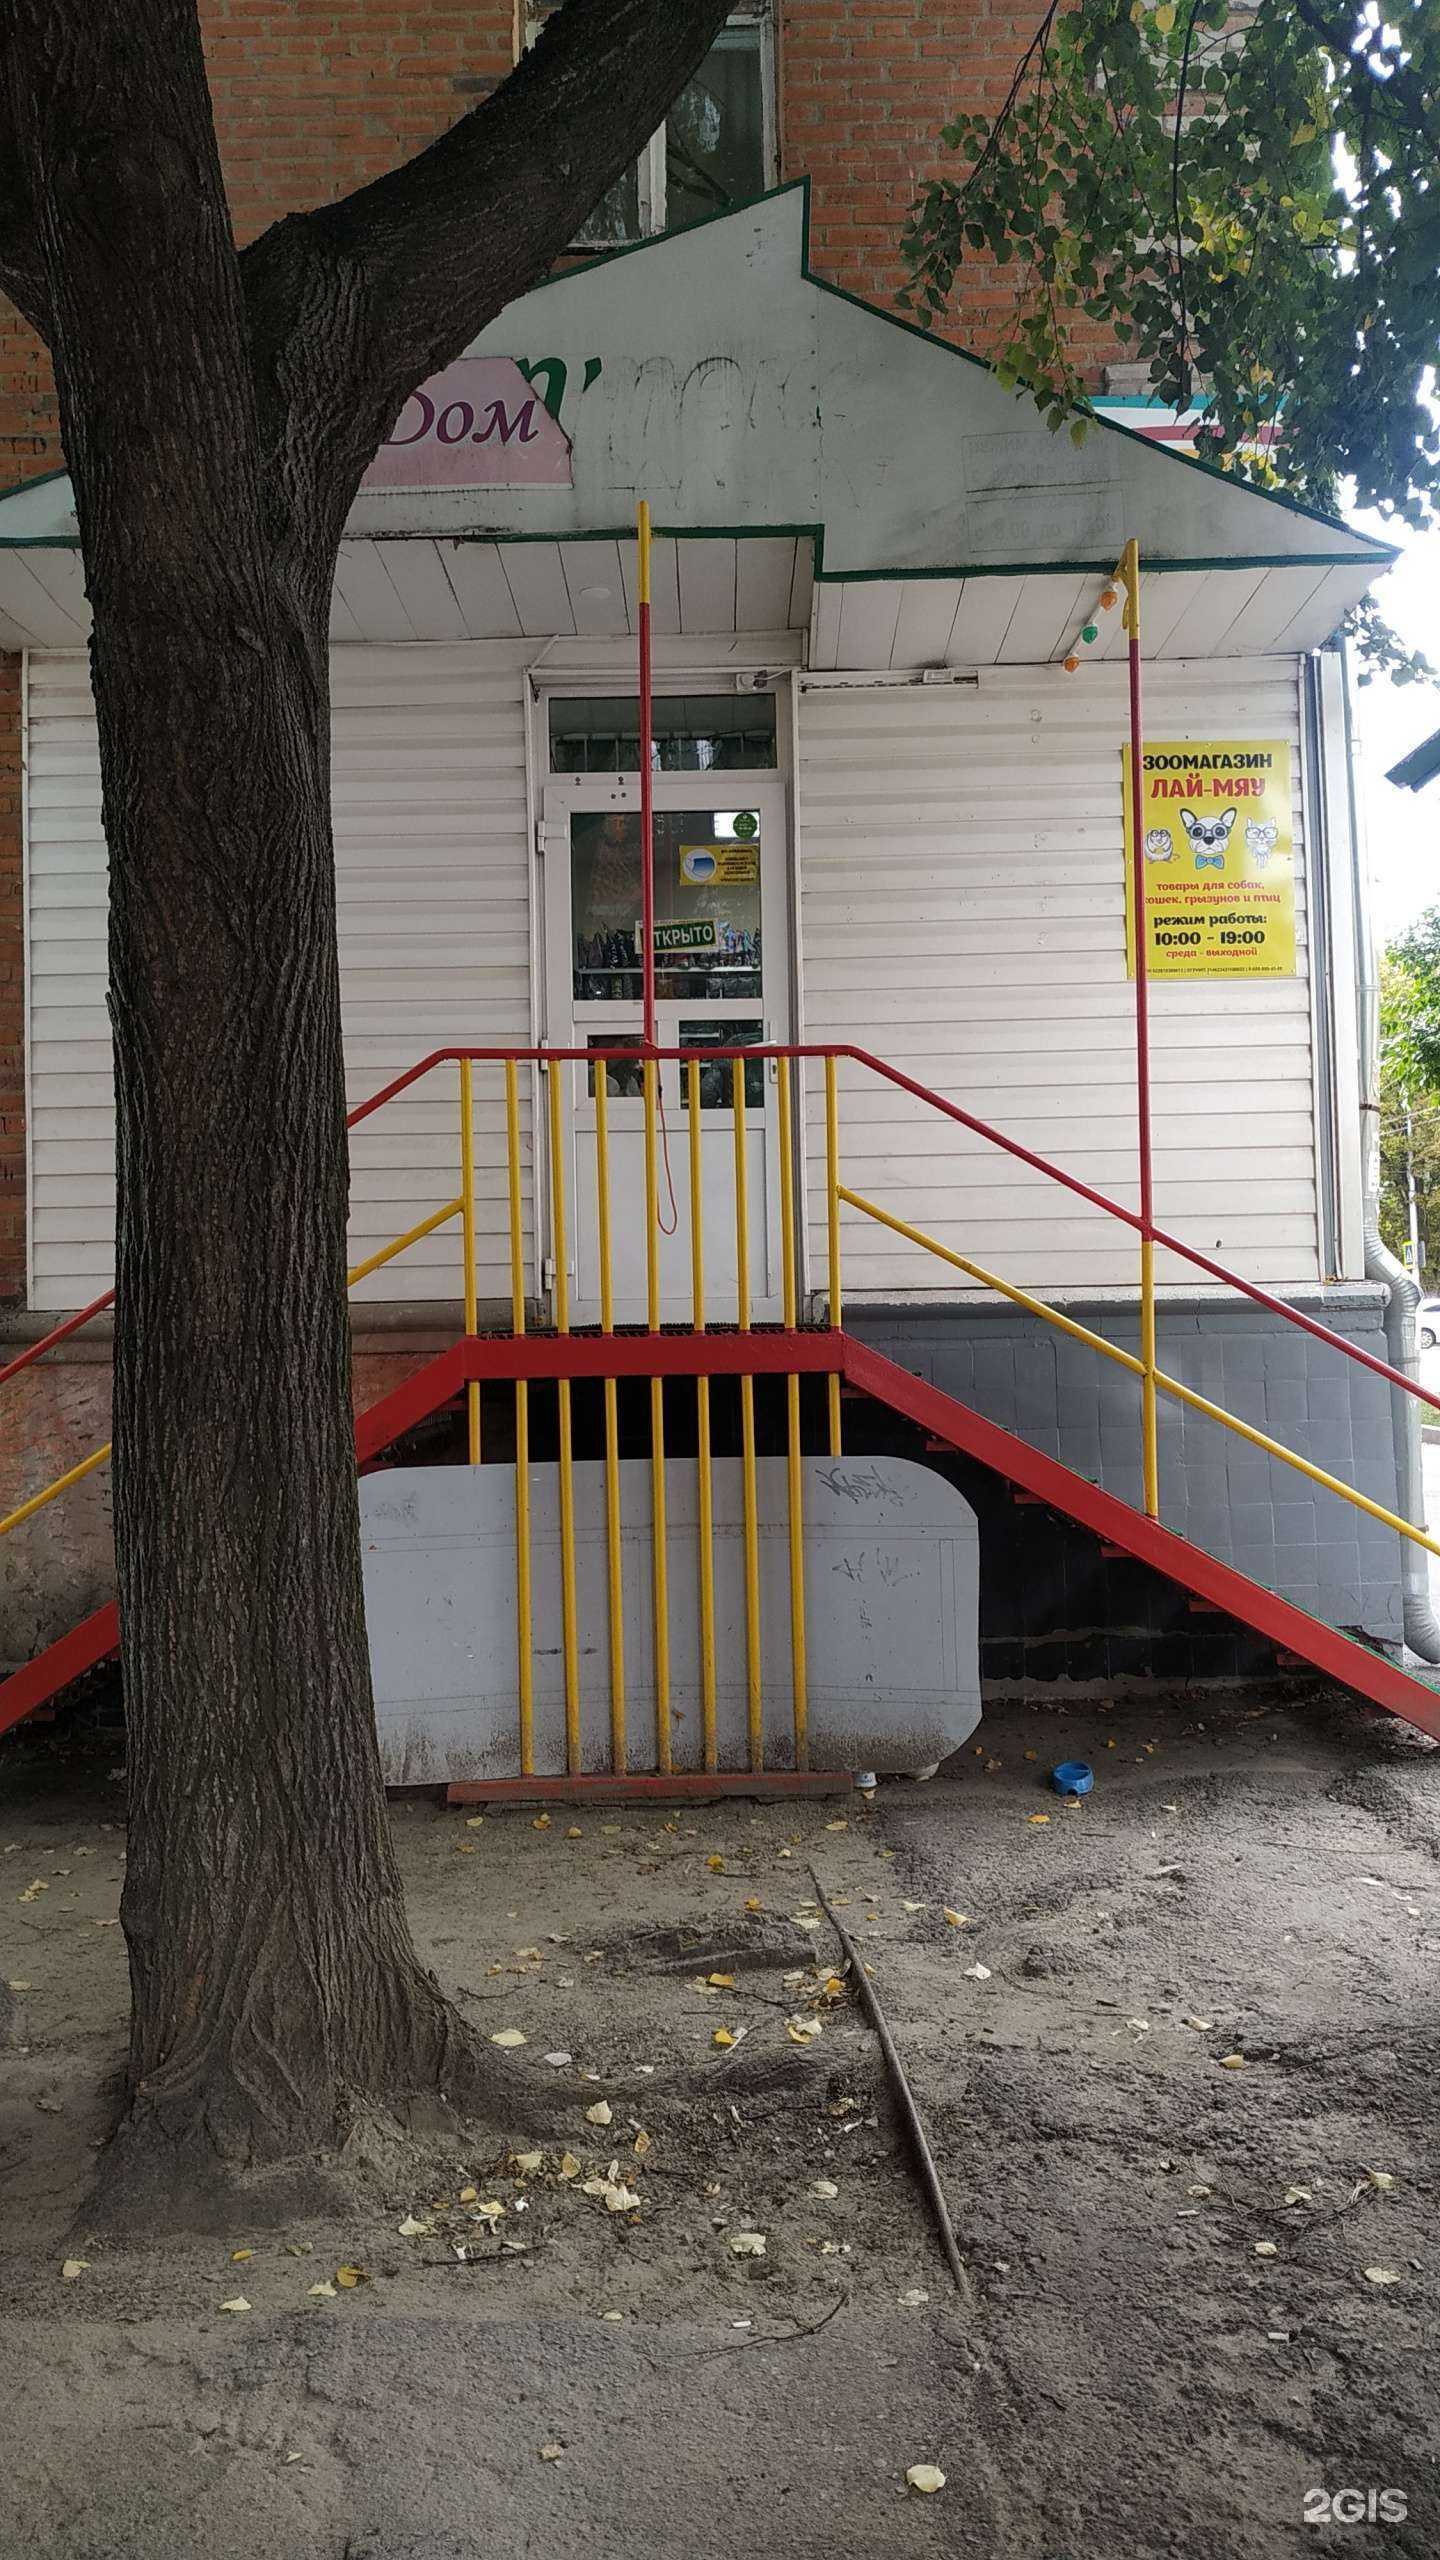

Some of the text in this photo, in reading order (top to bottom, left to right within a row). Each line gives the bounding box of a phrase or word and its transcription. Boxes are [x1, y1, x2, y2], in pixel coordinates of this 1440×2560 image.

[1143, 753, 1273, 770] ЗООМАГАЗИН
[1151, 772, 1266, 799] ЛАЙ-МЯУ
[1156, 882, 1200, 893] товары
[1202, 881, 1225, 891] для
[1184, 894, 1240, 906] грызунов
[1243, 894, 1251, 902] и
[1253, 893, 1281, 904] птиц
[1153, 912, 1268, 929] режим работы:
[653, 925, 713, 947] ТКРЫТО
[1155, 931, 1202, 946] 10:00
[1220, 930, 1266, 945] 19:00
[1166, 949, 1197, 960] среда
[1205, 947, 1258, 958] выходной
